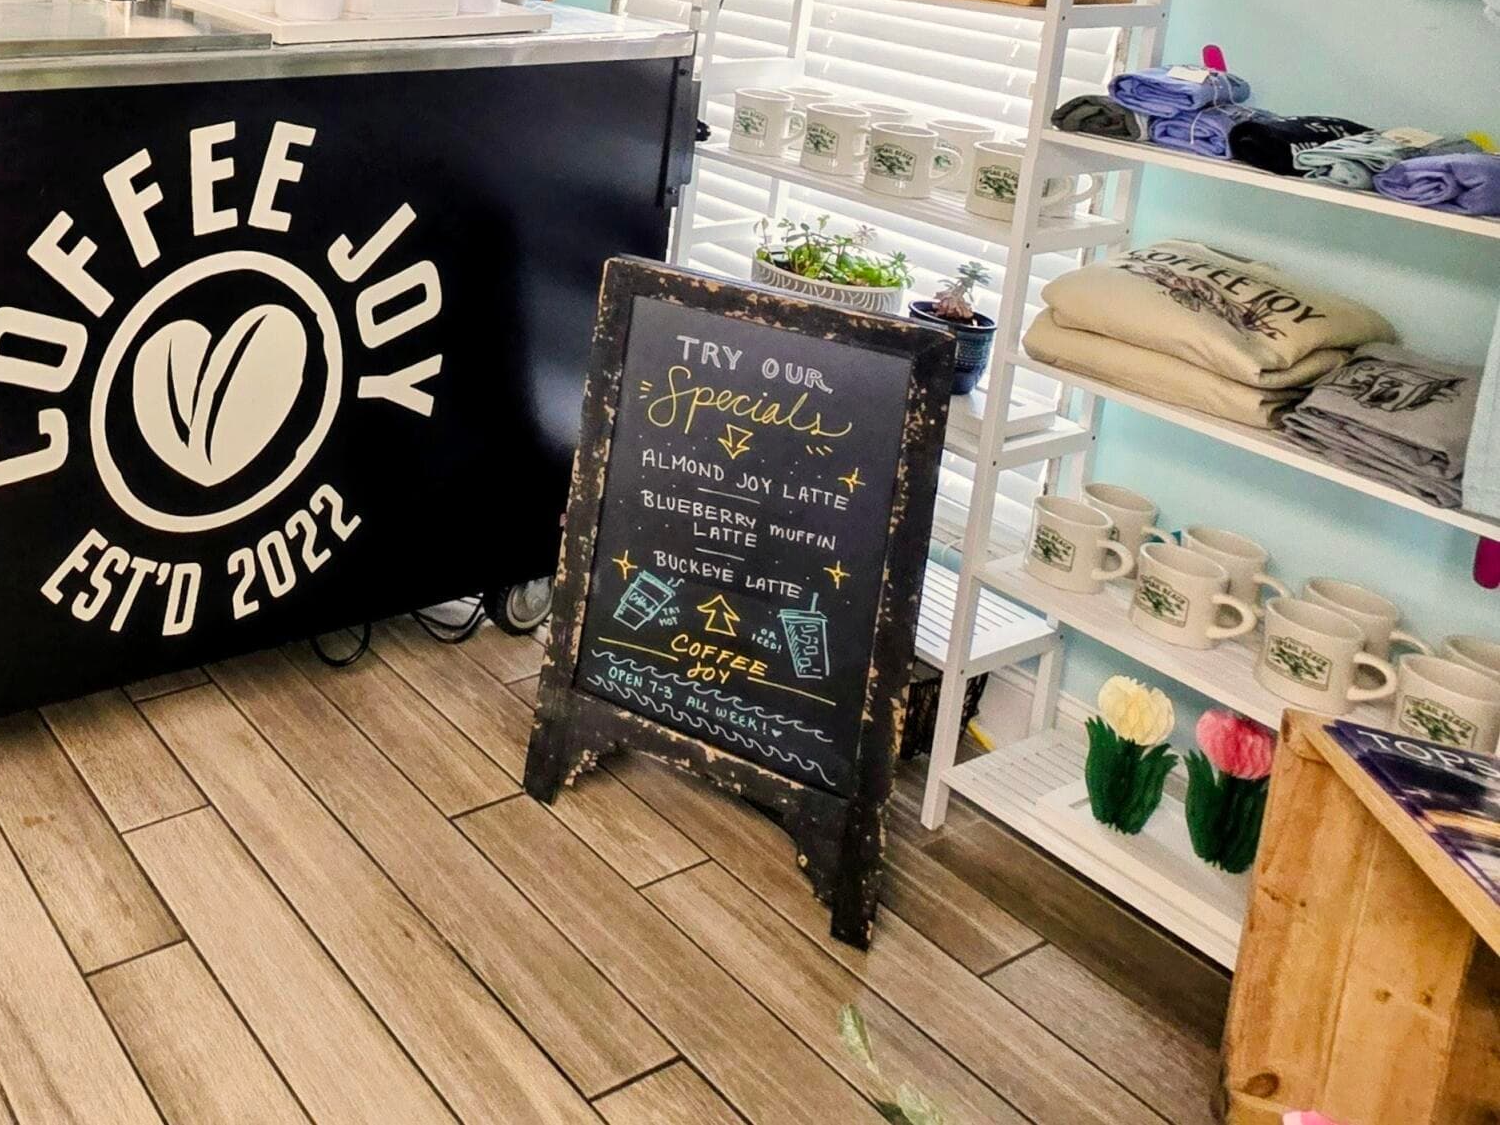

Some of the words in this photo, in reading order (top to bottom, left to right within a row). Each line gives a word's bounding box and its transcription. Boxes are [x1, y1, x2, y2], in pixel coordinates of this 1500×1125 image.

[327, 202, 443, 418] JOY
[1129, 249, 1250, 296] COFFEE
[1244, 289, 1326, 324] JOY
[676, 335, 743, 371] TRY
[761, 358, 834, 395] OUR
[648, 365, 853, 437] Specials
[642, 449, 725, 483] ALMOND
[736, 473, 773, 496] JOY
[783, 484, 850, 511] LATTE
[640, 490, 757, 529] BLUEBERRY
[40, 528, 201, 637] EST'D
[226, 483, 362, 620] 2022
[694, 523, 758, 548] LATTE
[653, 550, 734, 583] BUCKEYE
[746, 575, 803, 599] LATTE
[658, 616, 679, 627] HOT
[751, 633, 782, 655] ICED!
[760, 627, 776, 639] OR
[671, 634, 769, 677] COFFEE
[687, 662, 730, 685] JOY
[608, 666, 643, 687] OPEN
[649, 680, 673, 700] 7-3
[686, 696, 709, 714] ALL
[716, 708, 768, 735] WEEK!
